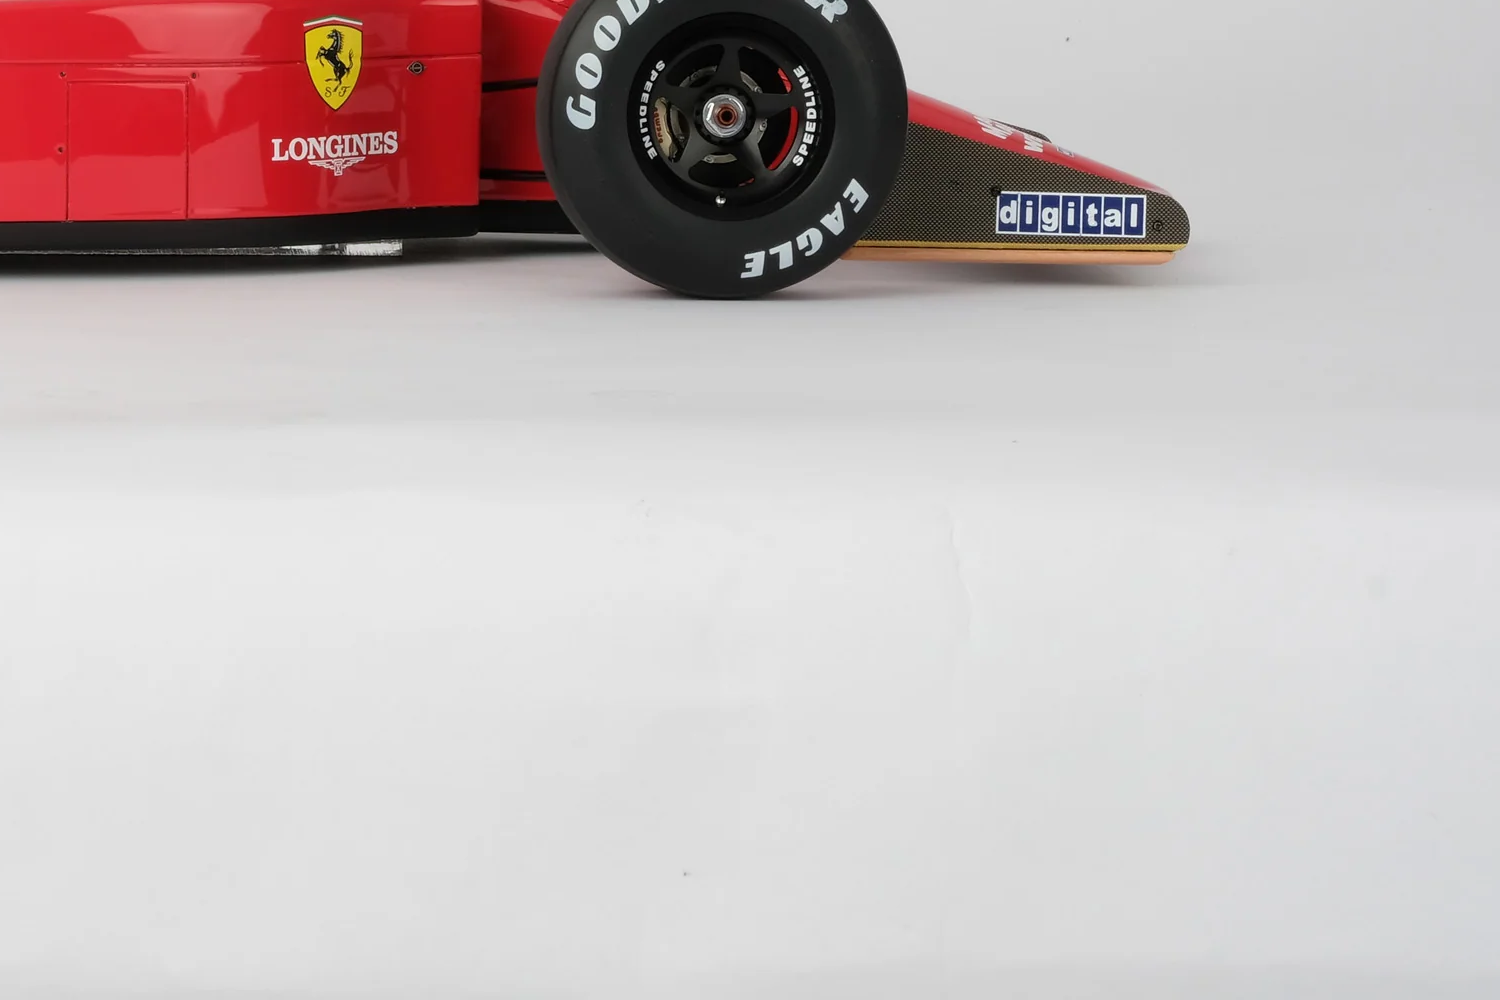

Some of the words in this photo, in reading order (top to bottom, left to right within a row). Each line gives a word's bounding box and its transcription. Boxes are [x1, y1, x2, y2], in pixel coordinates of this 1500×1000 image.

[271, 131, 399, 161] LONGINES
[639, 60, 666, 160] SPEEDLINE
[792, 65, 817, 167] SPEEDLINE
[740, 178, 869, 278] EAGLE
[1000, 200, 1138, 232] digital
